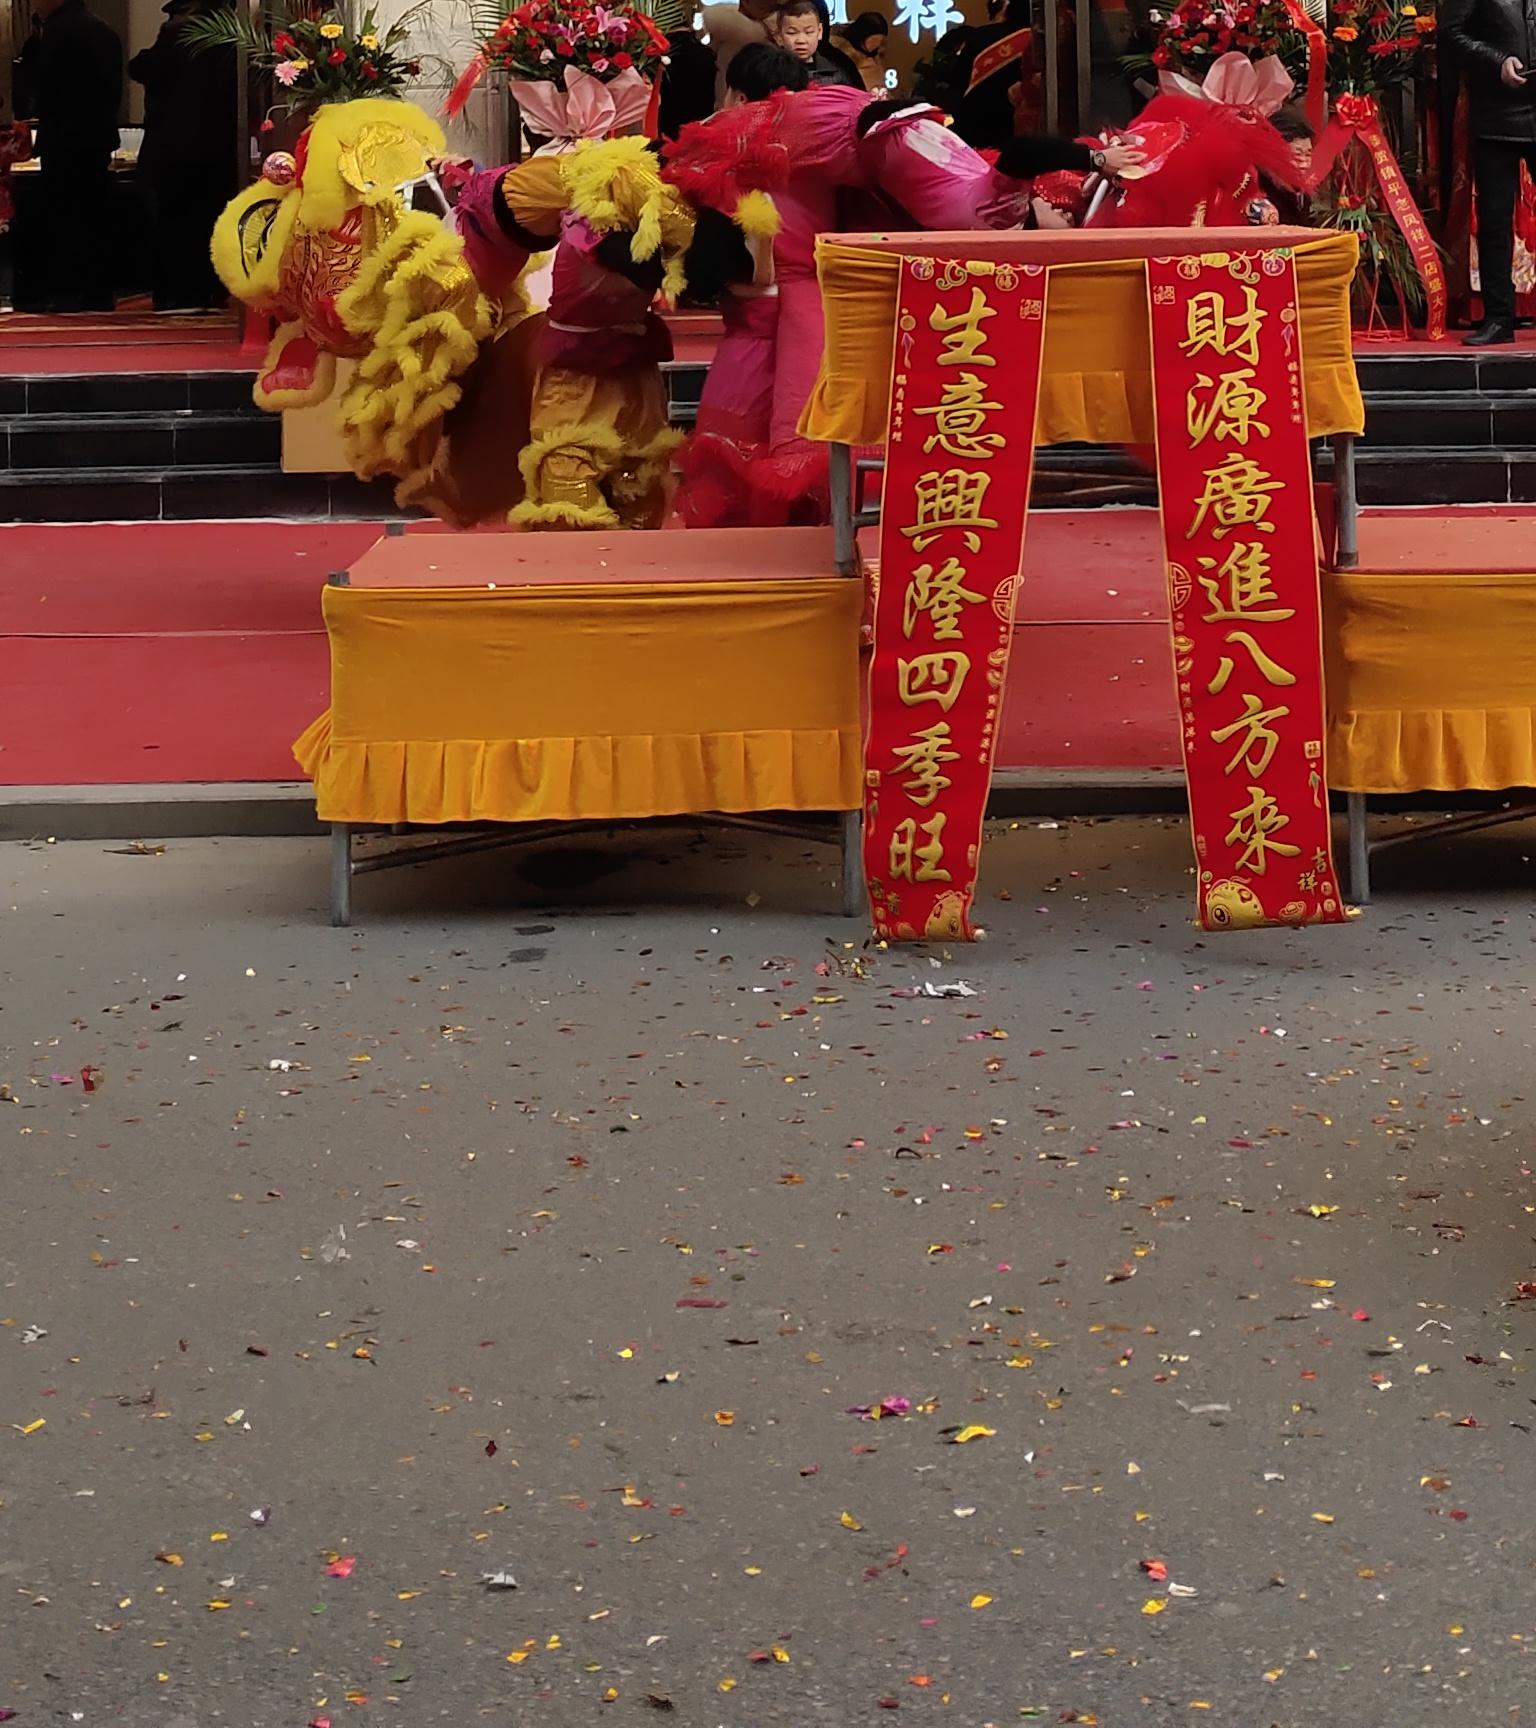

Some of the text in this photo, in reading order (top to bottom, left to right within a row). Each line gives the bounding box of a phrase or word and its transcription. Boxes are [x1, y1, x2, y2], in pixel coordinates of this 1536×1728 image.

[886, 286, 1006, 885] 生意興隆四季旺
[1178, 285, 1302, 875] 財源廣進八方來
